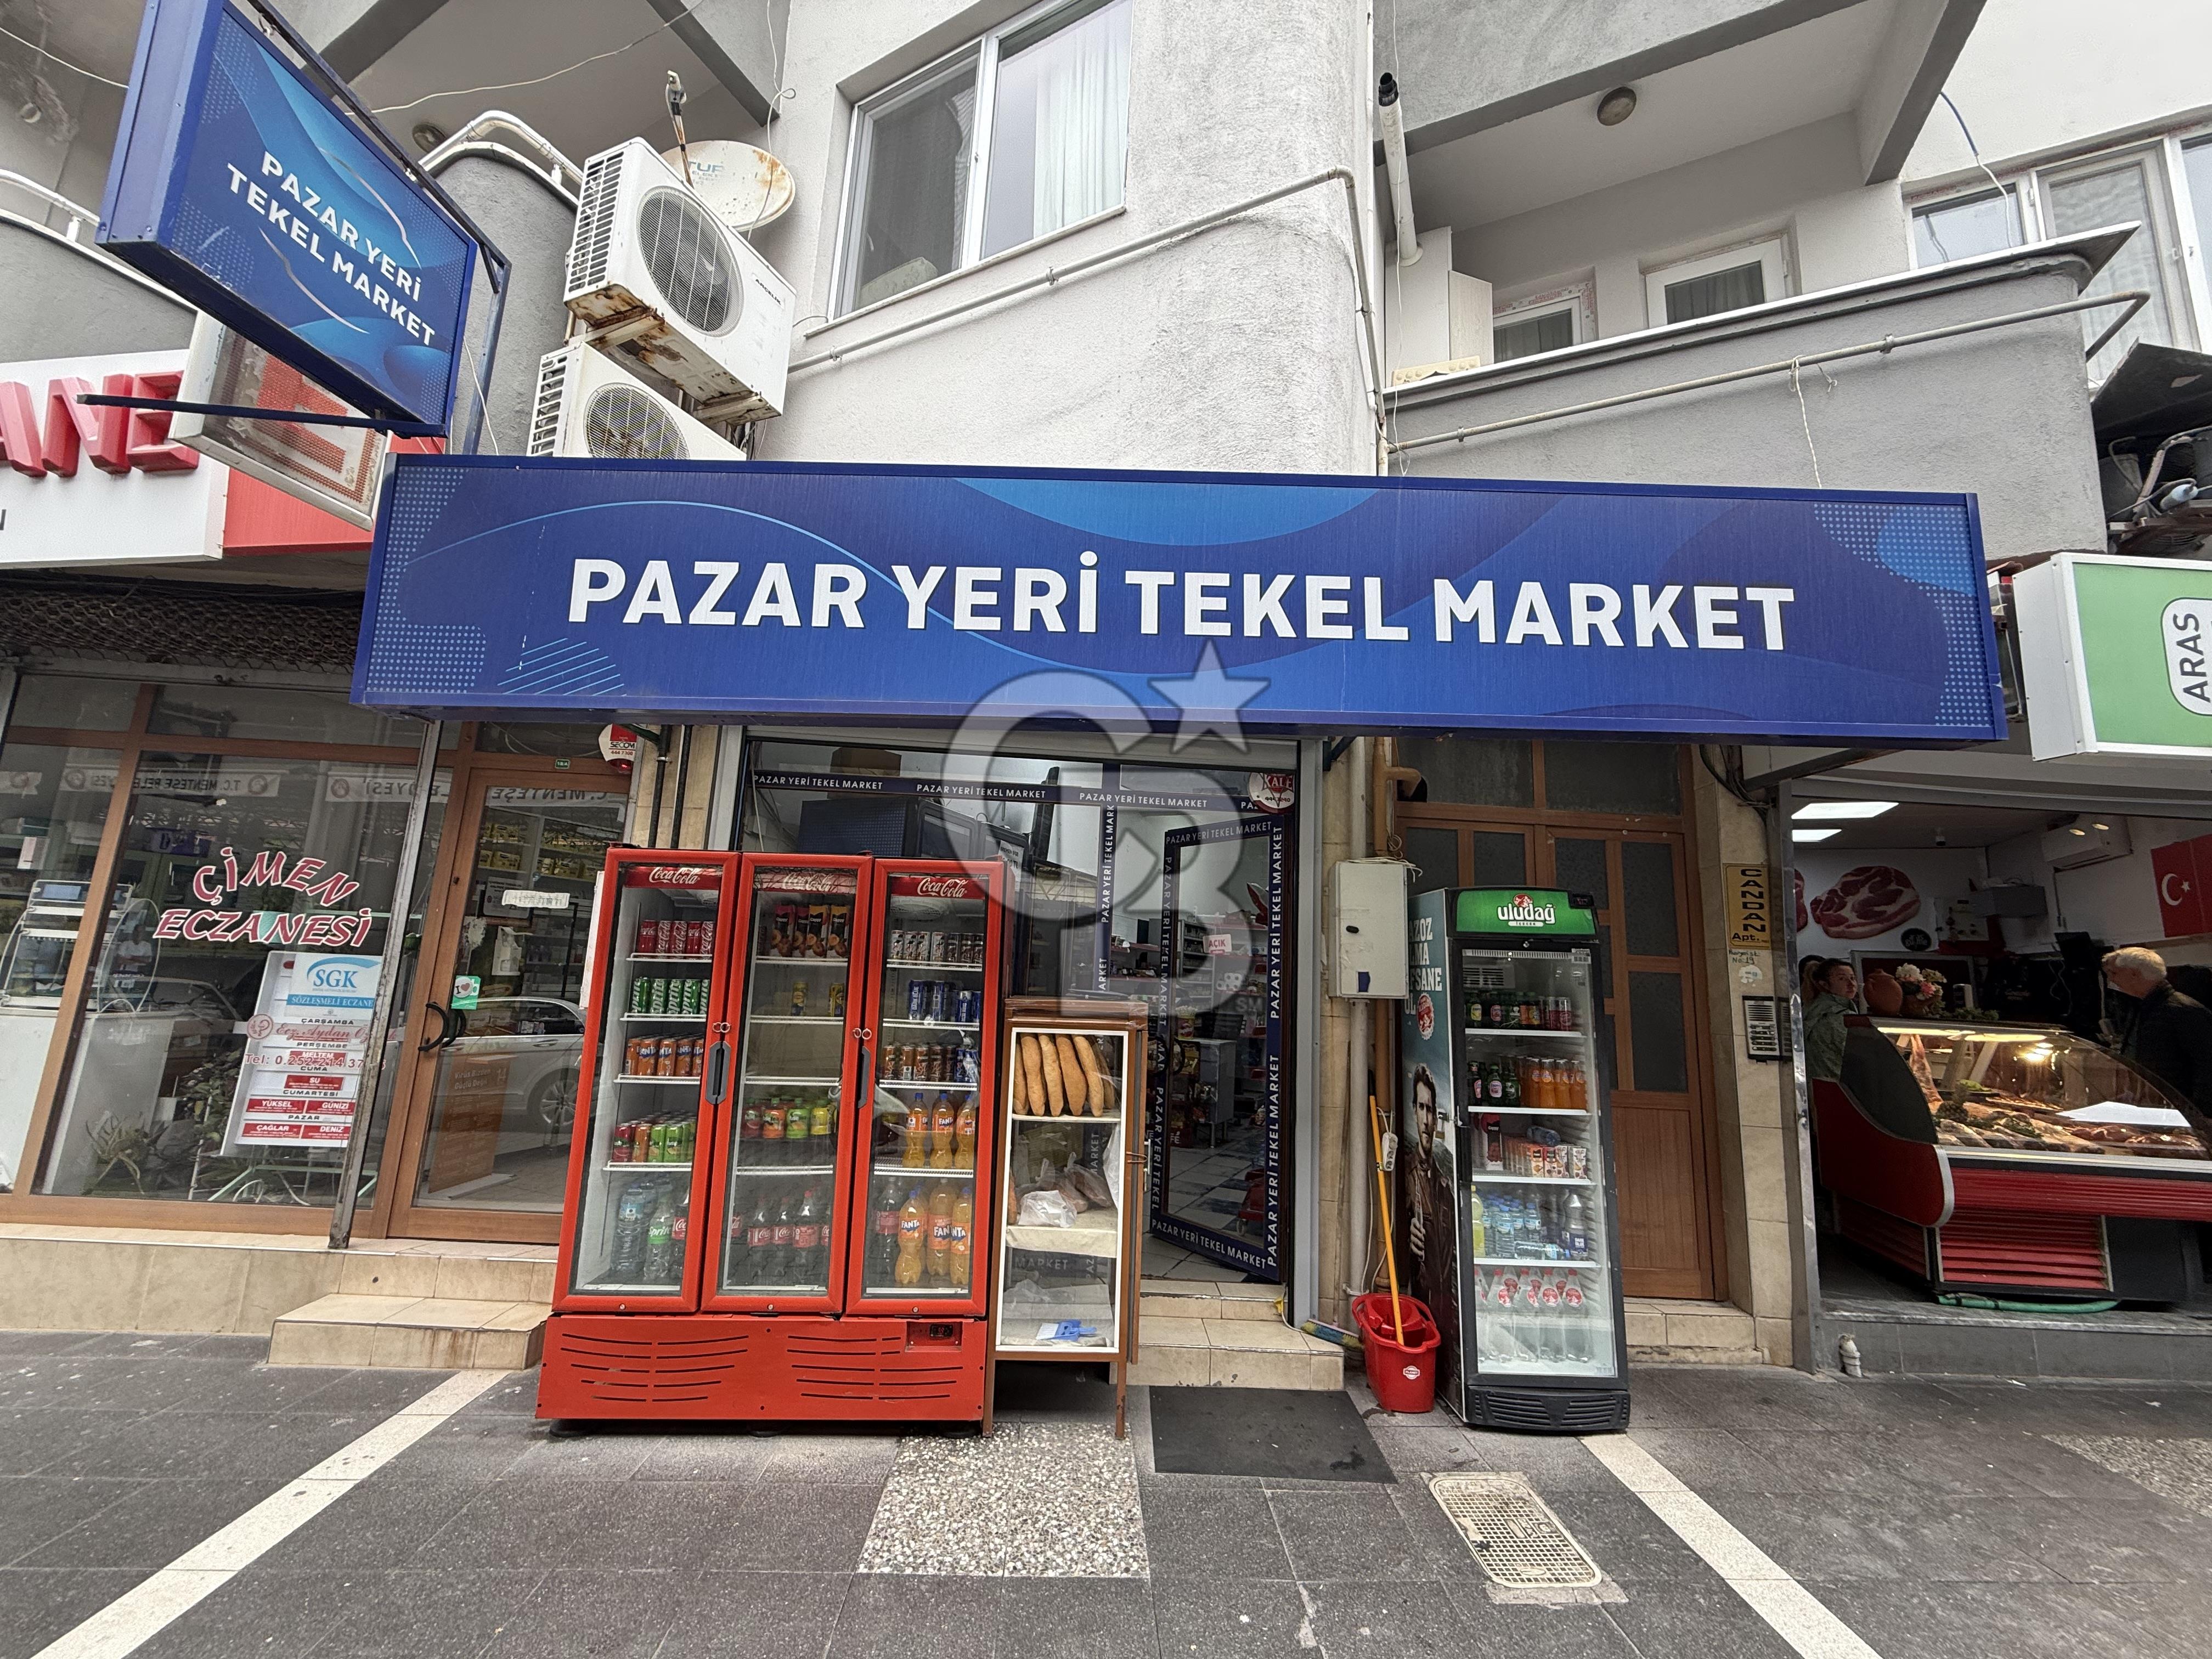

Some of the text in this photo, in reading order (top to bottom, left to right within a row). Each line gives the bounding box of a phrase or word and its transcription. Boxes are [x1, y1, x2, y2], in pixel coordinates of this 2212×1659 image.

[262, 151, 422, 302] PAZAR YERİ
[227, 162, 435, 346] TEKEL MARKET
[568, 551, 1795, 651] PAZAR YERİ TEKEL MARKET
[2172, 613, 2211, 703] ARAS
[754, 775, 882, 790] PAZAR YERİ TEKEL MARKET
[916, 785, 1045, 798] PAZAR YERİ TEKEL MARKET
[1265, 775, 1293, 789] KALE
[1080, 793, 1207, 808] PAZAR YERİ TEKEL MARKET
[1104, 836, 1114, 863] TEKEL
[1166, 833, 1190, 845] PAZAR
[1211, 827, 1234, 838] TEKEL
[1236, 821, 1272, 834] MARKET
[193, 847, 359, 906] ÇİMEN
[1103, 865, 1111, 888] YERİ
[1163, 856, 1172, 901] PAZAR
[1102, 889, 1110, 923] PAZAR
[1497, 903, 1556, 924] uludağ
[1740, 868, 1767, 933] CANDAN
[152, 907, 372, 947] ECZANESİ
[1270, 827, 1282, 1018] PAZAR YERİ TEKEL MARKET
[1731, 932, 1760, 942] Apt.
[1161, 933, 1170, 969] TEKEL
[1209, 939, 1226, 949] AÇIK
[313, 969, 358, 989] SGK
[1098, 958, 1107, 991] ARKET
[292, 995, 374, 1007] SÖZLEŞMELİ ECZANE
[1159, 977, 1169, 1026] MARKET
[262, 1099, 292, 1108] YÜKSEL
[1154, 1087, 1164, 1133] PAZAR
[1267, 1055, 1280, 1267] PAZAR YERİ TEKEL MARKET
[1152, 1171, 1161, 1209] TEKEL
[1152, 1218, 1178, 1237] PAZAR
[1200, 1235, 1226, 1254] TEKEL
[1227, 1245, 1266, 1269] MARKET
